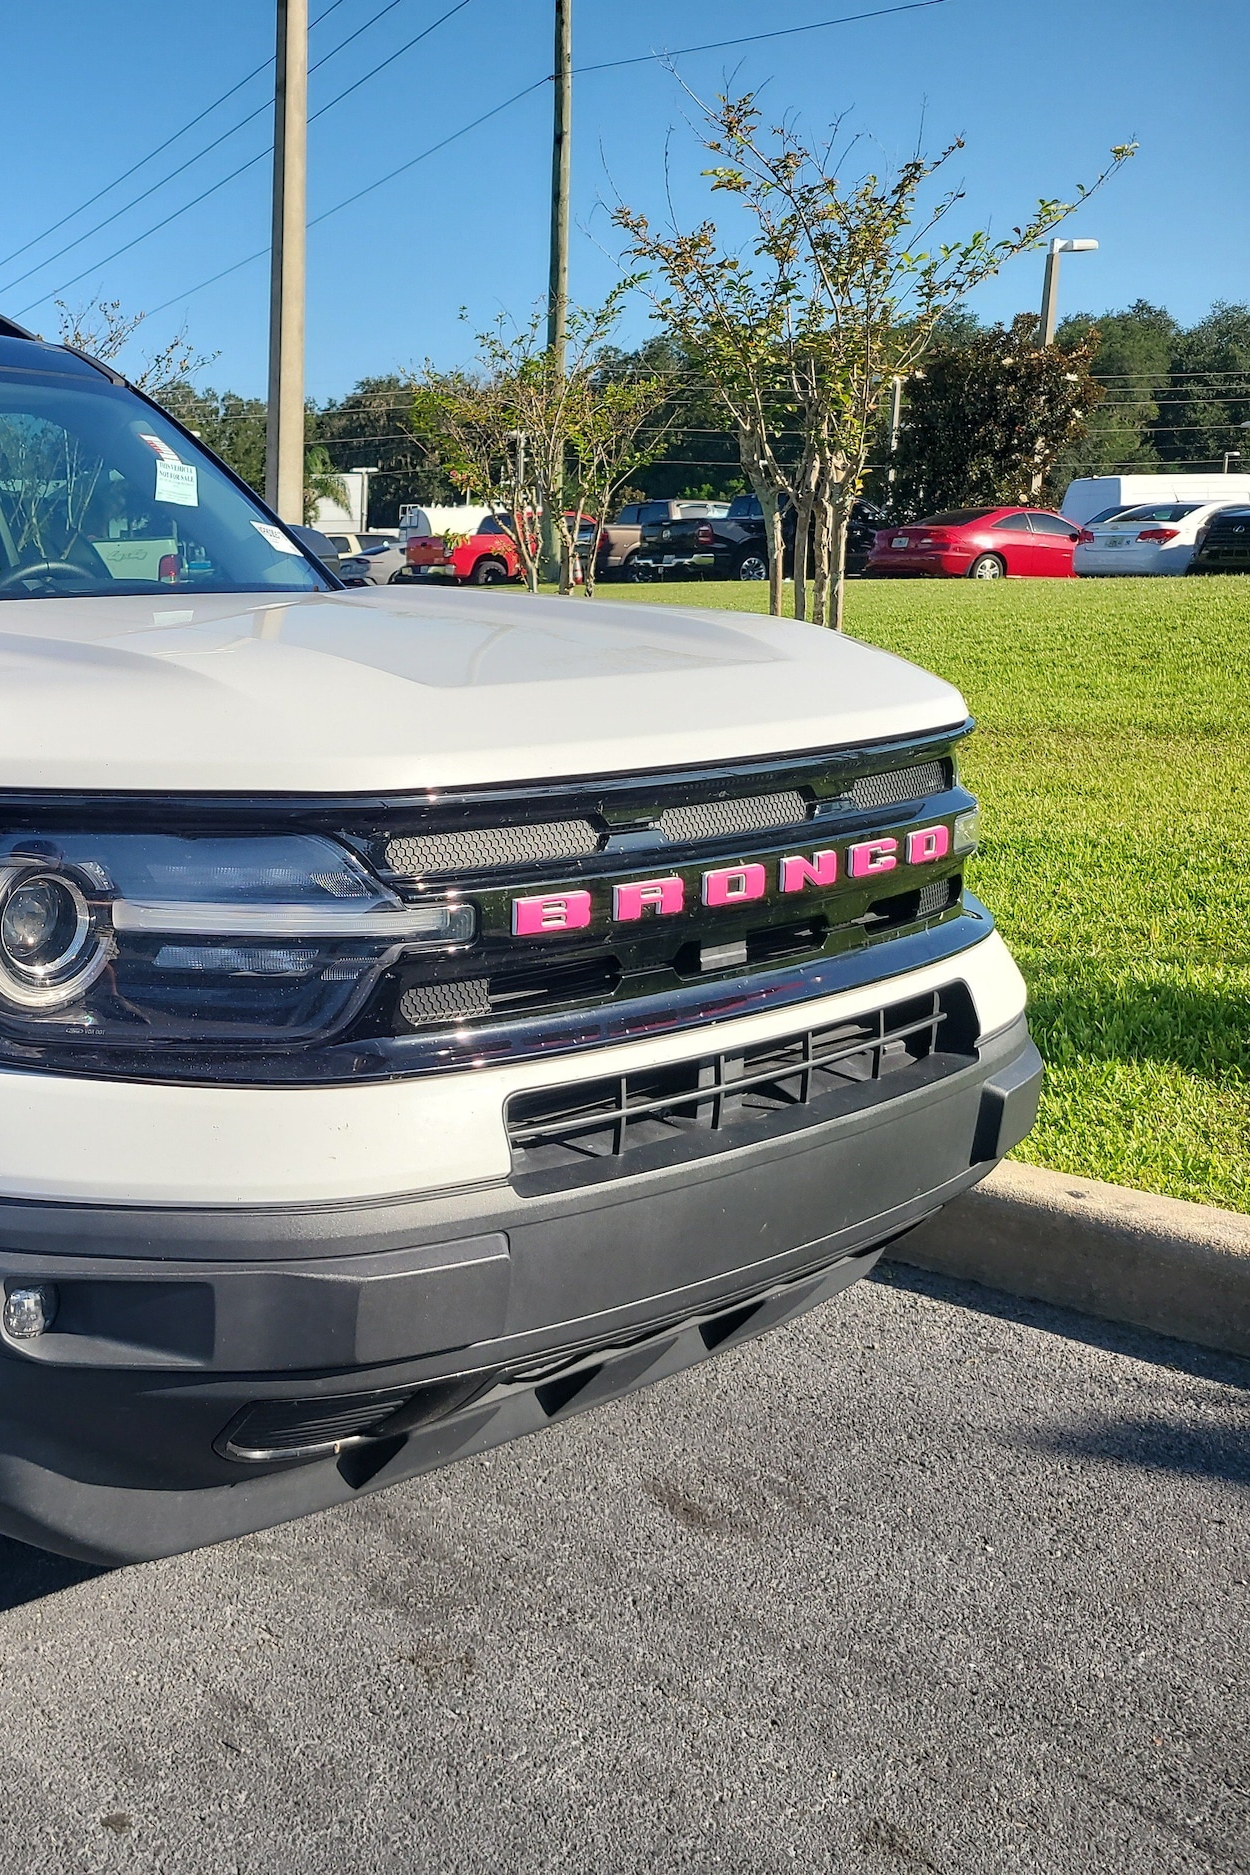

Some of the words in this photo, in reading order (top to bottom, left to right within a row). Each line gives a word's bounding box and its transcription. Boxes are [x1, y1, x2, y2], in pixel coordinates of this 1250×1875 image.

[159, 462, 170, 470] THIS
[170, 464, 193, 474] VEHICLE
[159, 470, 169, 478] NOT
[180, 475, 194, 483] SALE
[510, 824, 949, 937] BRONCO
